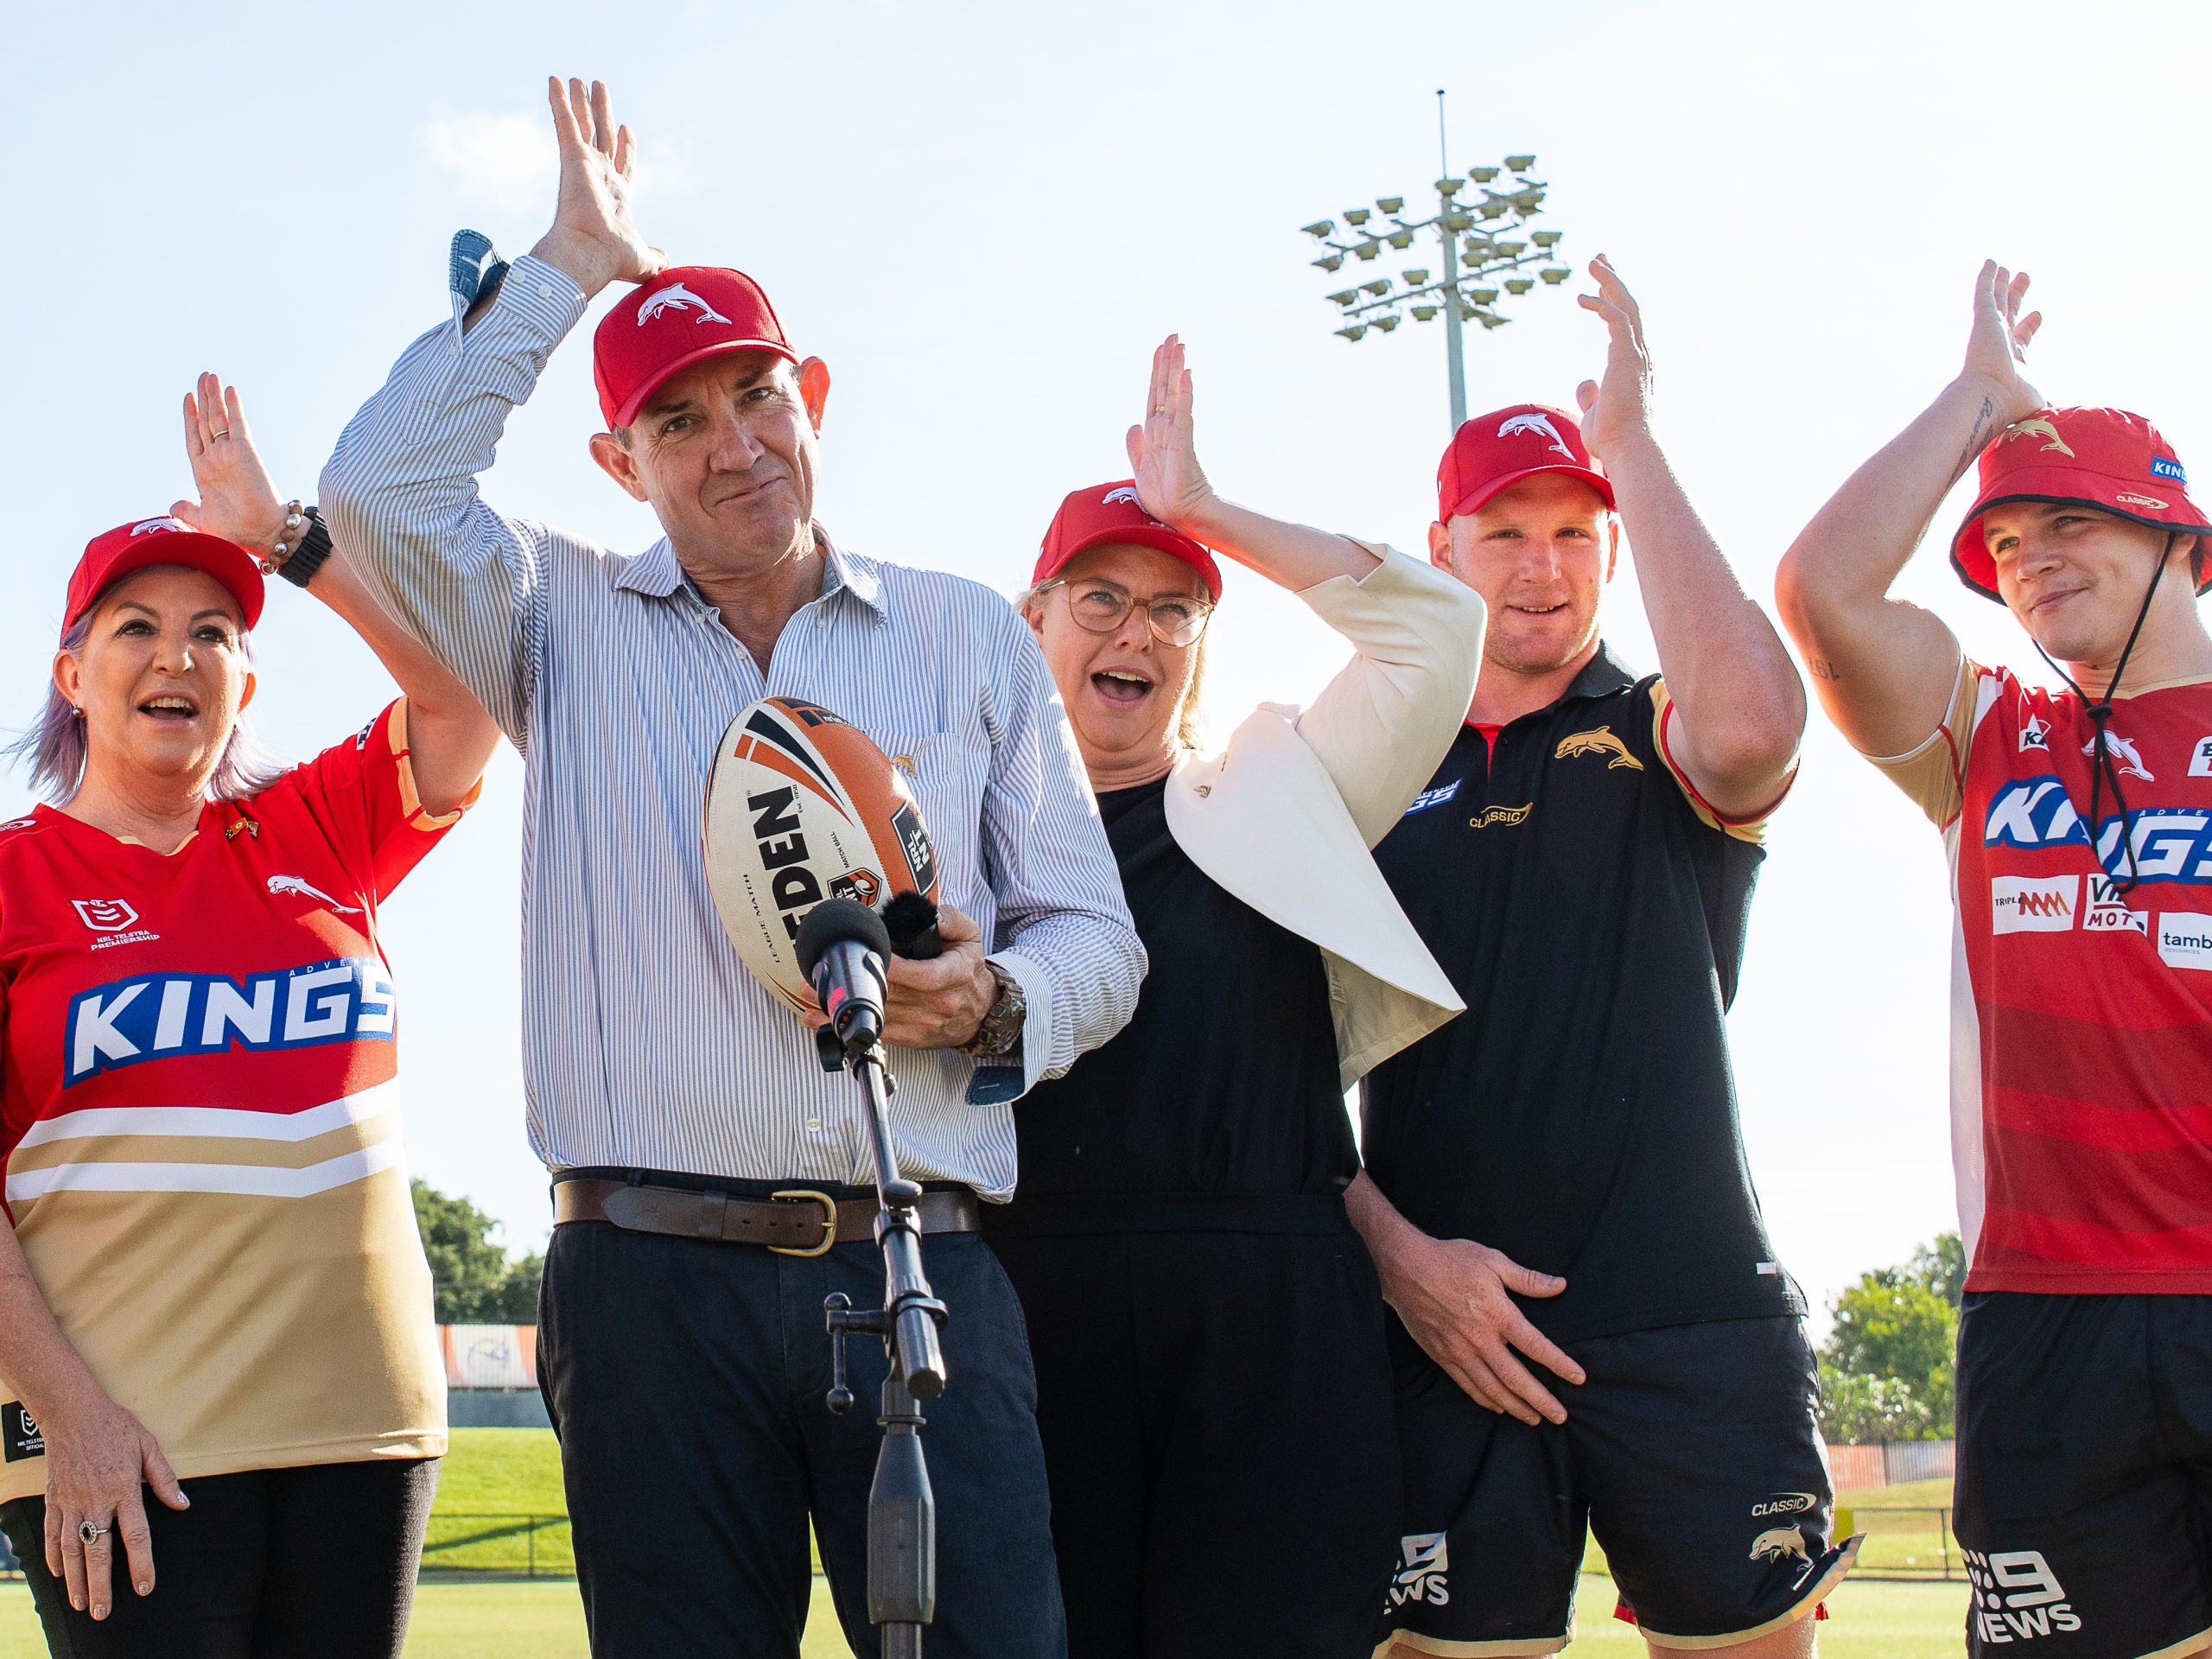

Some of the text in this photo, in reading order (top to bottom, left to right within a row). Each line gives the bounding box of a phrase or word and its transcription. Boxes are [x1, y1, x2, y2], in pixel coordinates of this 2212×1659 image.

[2117, 495, 2155, 507] CLASSIC
[1469, 811, 1521, 829] CLASSIC
[830, 831, 850, 868] MATCH BALL
[743, 874, 780, 963] LEAGUE MATCH
[90, 934, 161, 951] PREMIERSHIP
[96, 930, 150, 944] NRL TELSTRA
[73, 966, 396, 1076] KINGS
[1751, 1497, 1804, 1517] CLASSIC
